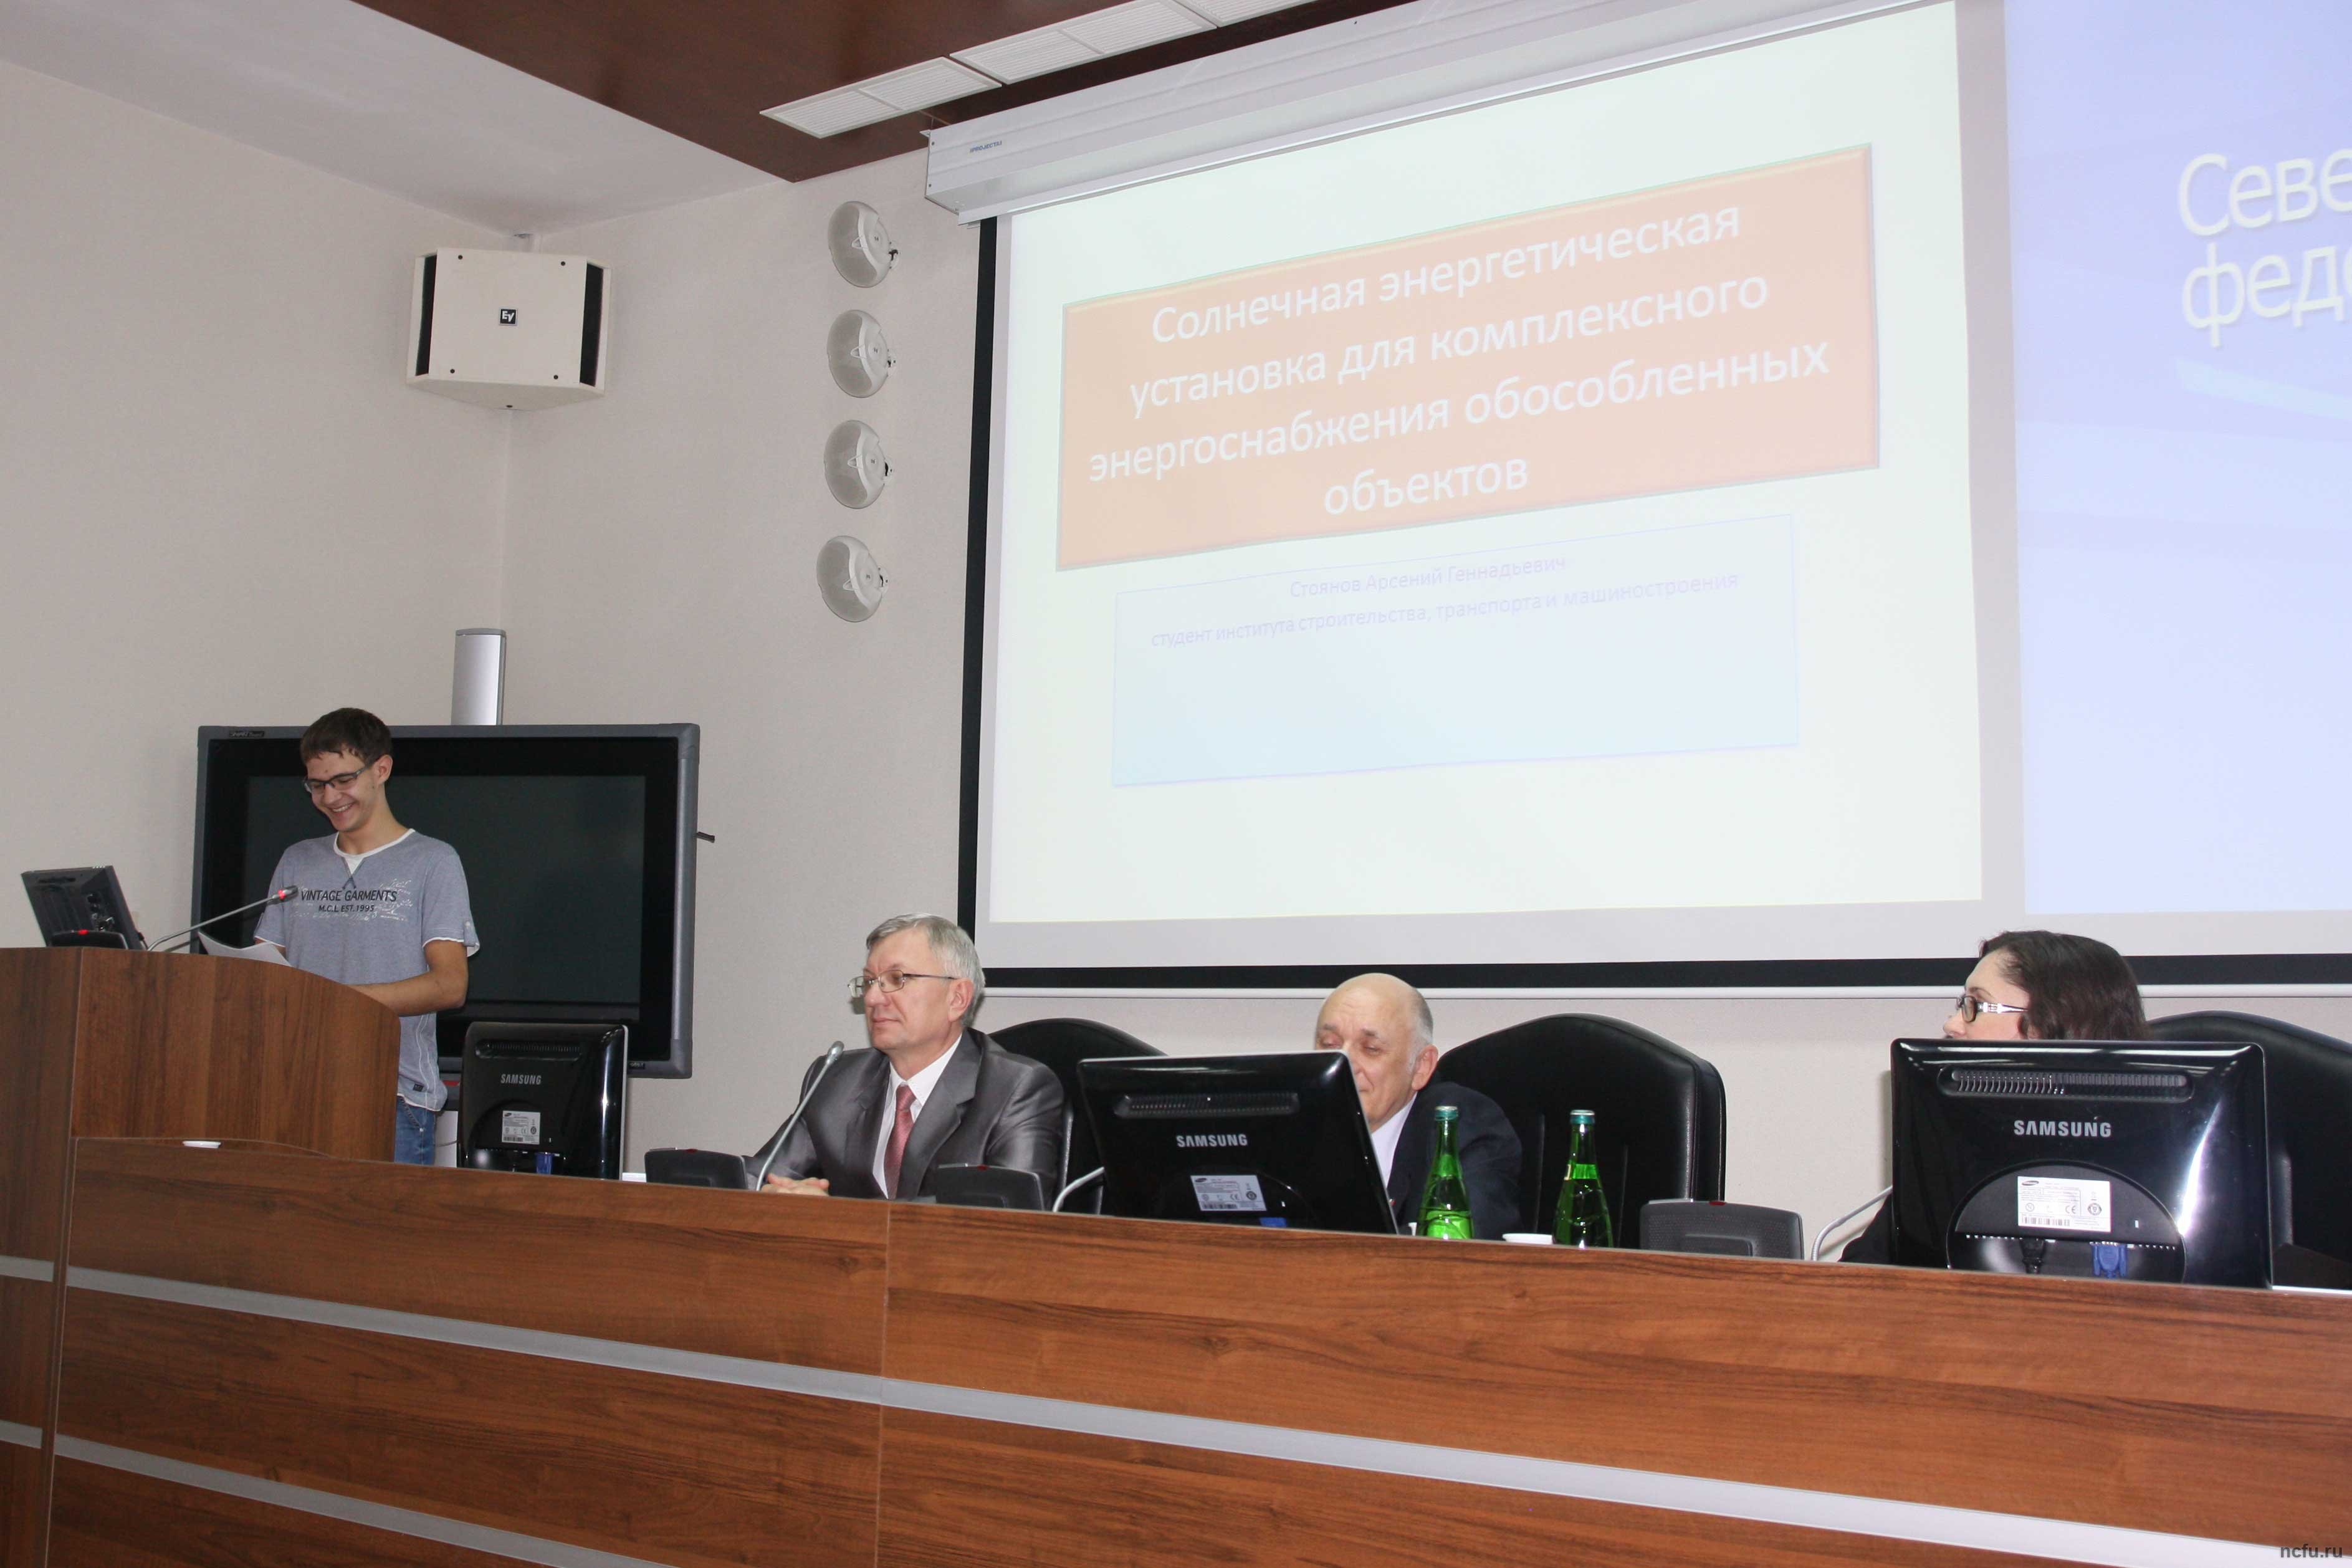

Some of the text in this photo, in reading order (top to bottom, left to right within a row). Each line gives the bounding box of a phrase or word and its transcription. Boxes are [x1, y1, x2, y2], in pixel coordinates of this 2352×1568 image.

[1152, 206, 1742, 343] Солнечная энергетическая
[2182, 241, 2352, 348] фед
[1129, 276, 1769, 419] установка для комплексного
[1088, 341, 1830, 483] энергоснабжения обособленных
[1324, 458, 1529, 515] объектов
[1289, 557, 1566, 598] Стоянов Арсений Геннадьевич
[1150, 573, 1739, 649] студент института строительства, транспорта и машиностроения
[301, 890, 398, 902] VINTAGE GARMENTS
[500, 1074, 542, 1085] SAMSUNG
[1176, 1133, 1248, 1147] SAMSUNG
[2014, 1120, 2111, 1137] SAMSUNG
